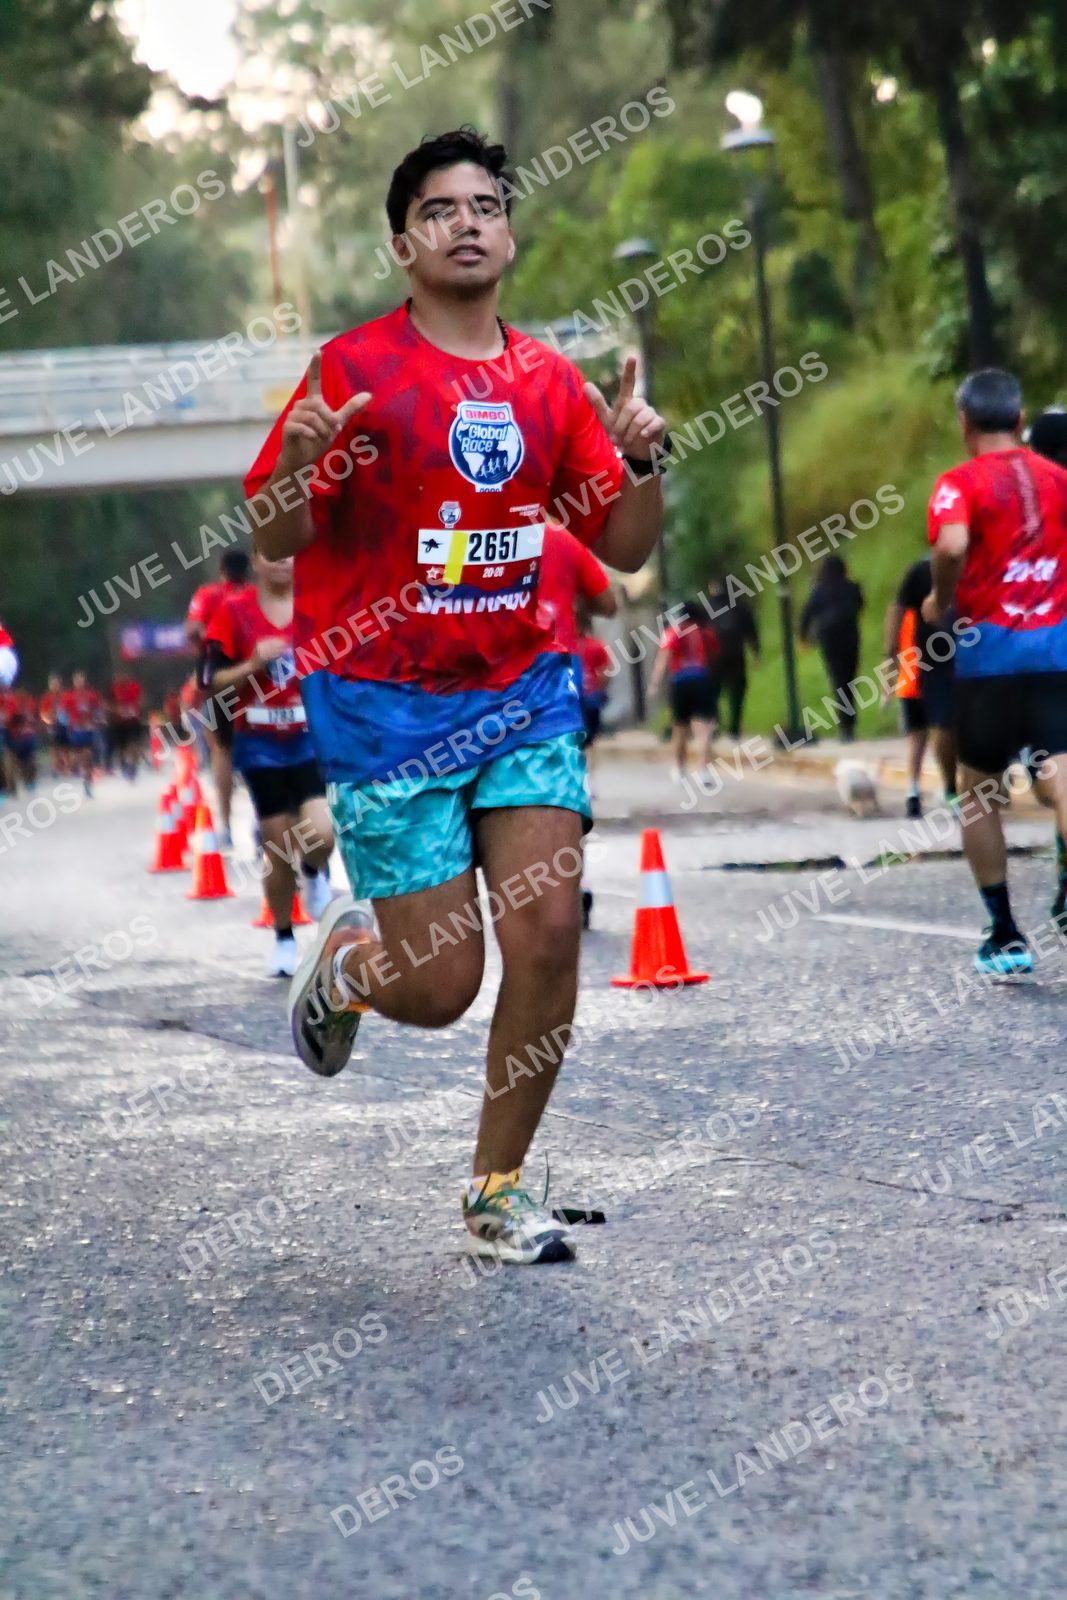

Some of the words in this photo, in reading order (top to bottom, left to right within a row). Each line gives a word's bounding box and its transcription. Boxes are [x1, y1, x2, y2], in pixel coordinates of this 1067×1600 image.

[465, 410, 506, 420] BIMBO
[468, 424, 508, 441] Global
[461, 438, 494, 452] Race
[468, 530, 519, 562] 2651
